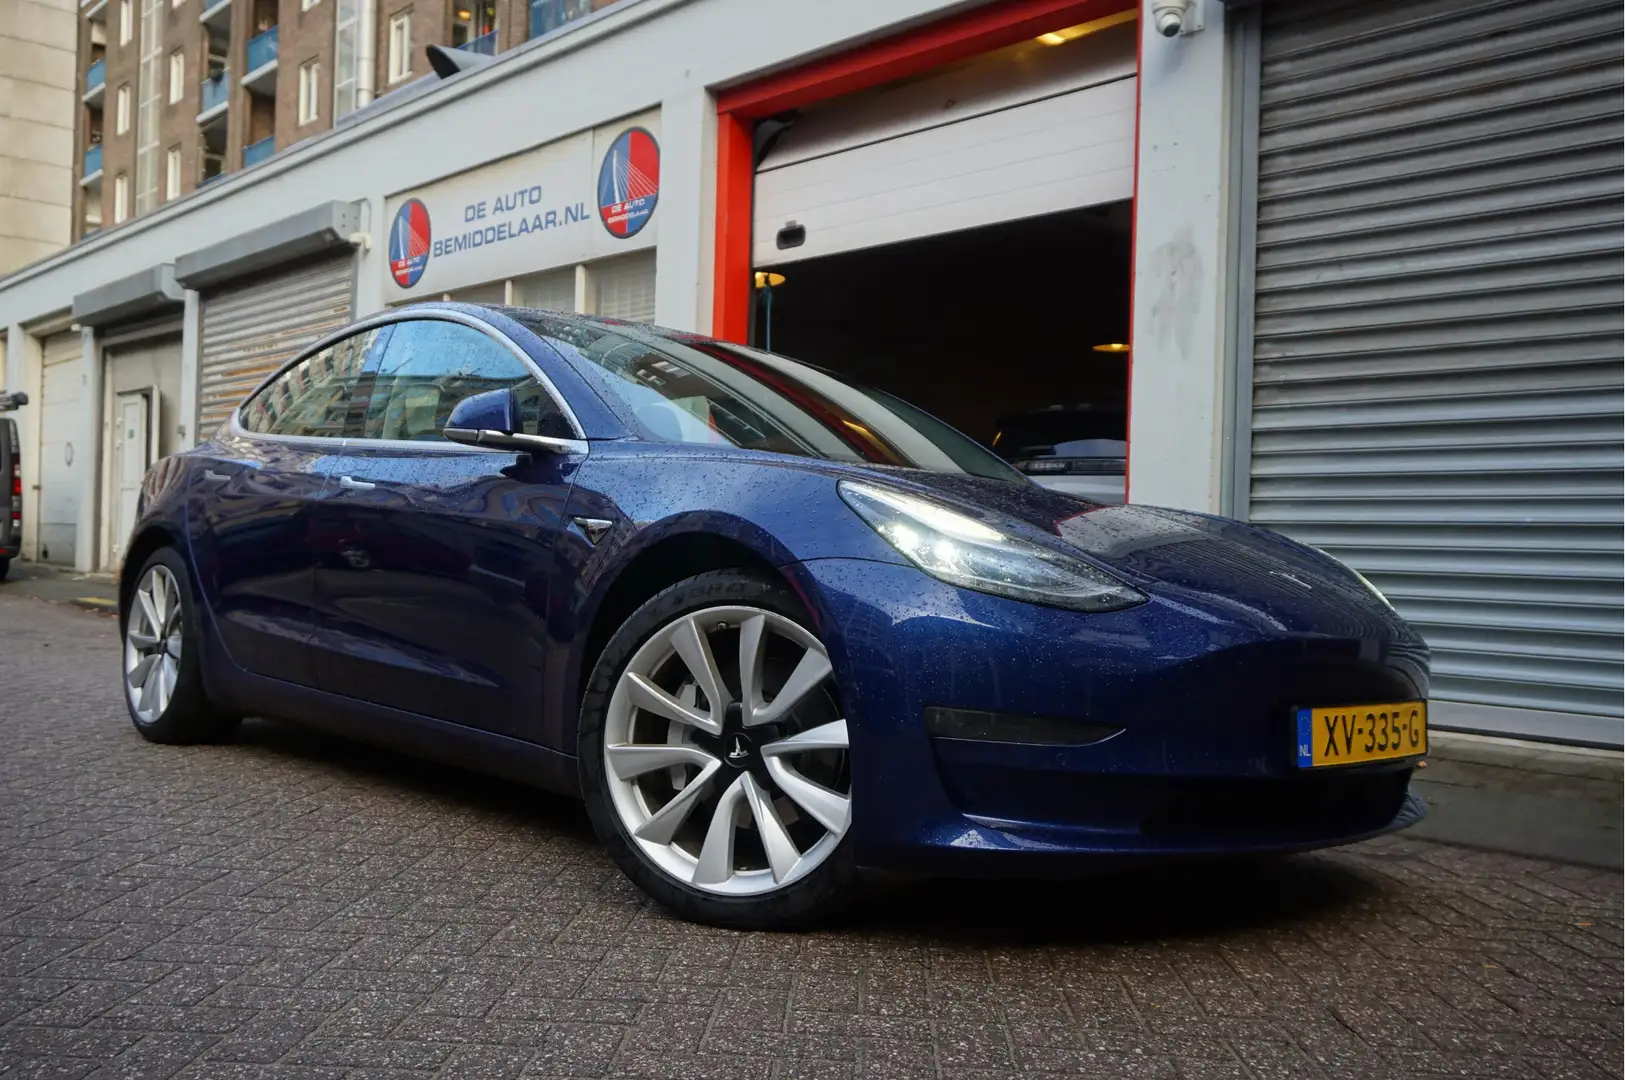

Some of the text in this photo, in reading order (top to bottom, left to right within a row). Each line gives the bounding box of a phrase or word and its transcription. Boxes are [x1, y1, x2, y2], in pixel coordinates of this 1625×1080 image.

[464, 185, 542, 223] DE AUTO
[611, 198, 646, 215] DE AUTO
[432, 202, 591, 258] BEMIDDELAAR.NL
[1299, 744, 1312, 757] NL
[1323, 709, 1420, 757] XV-335-G
